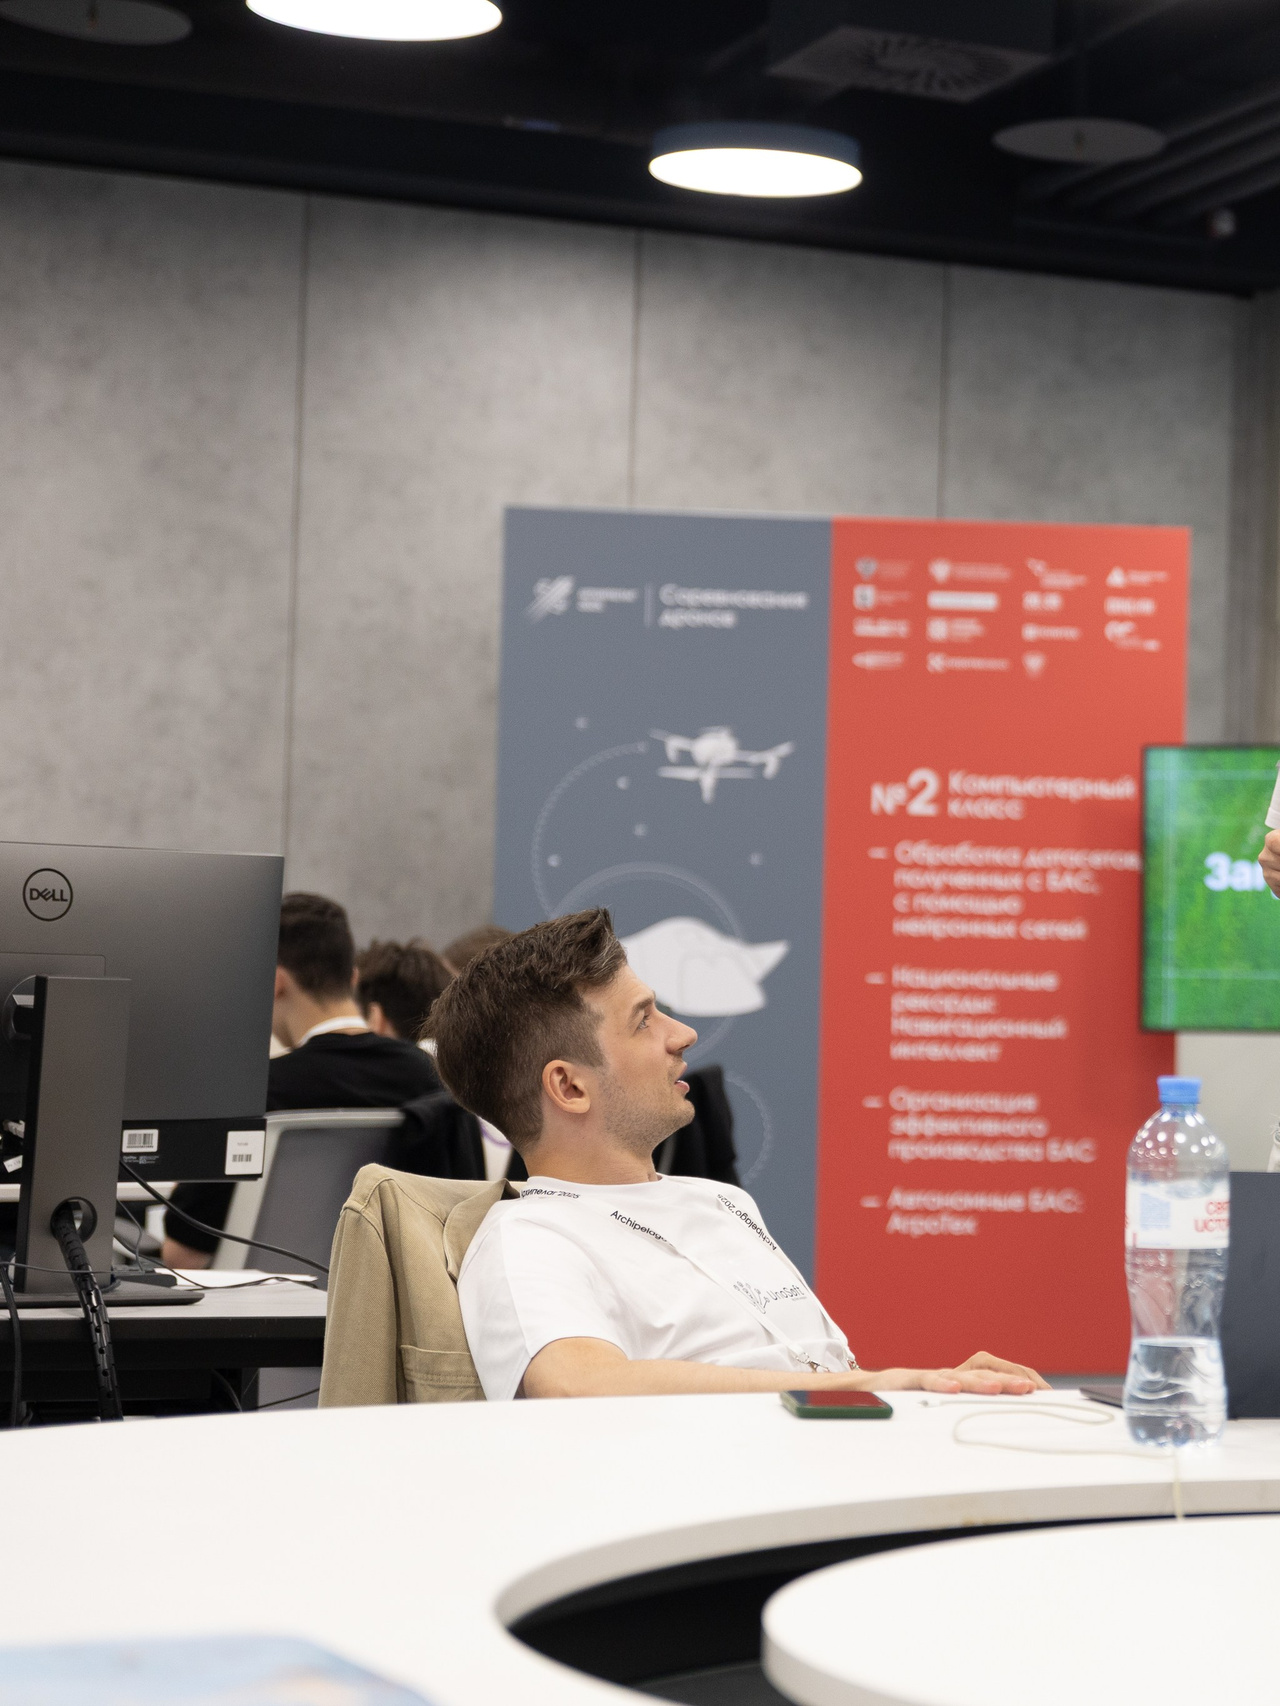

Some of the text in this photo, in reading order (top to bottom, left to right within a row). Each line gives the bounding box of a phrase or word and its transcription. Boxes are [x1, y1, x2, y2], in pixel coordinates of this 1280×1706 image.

[949, 770, 1136, 802] Компьютерный
[948, 798, 1024, 820] класс
[895, 841, 1022, 867] Обработка
[30, 888, 68, 902] DELL
[887, 1188, 1025, 1211] Автономные
